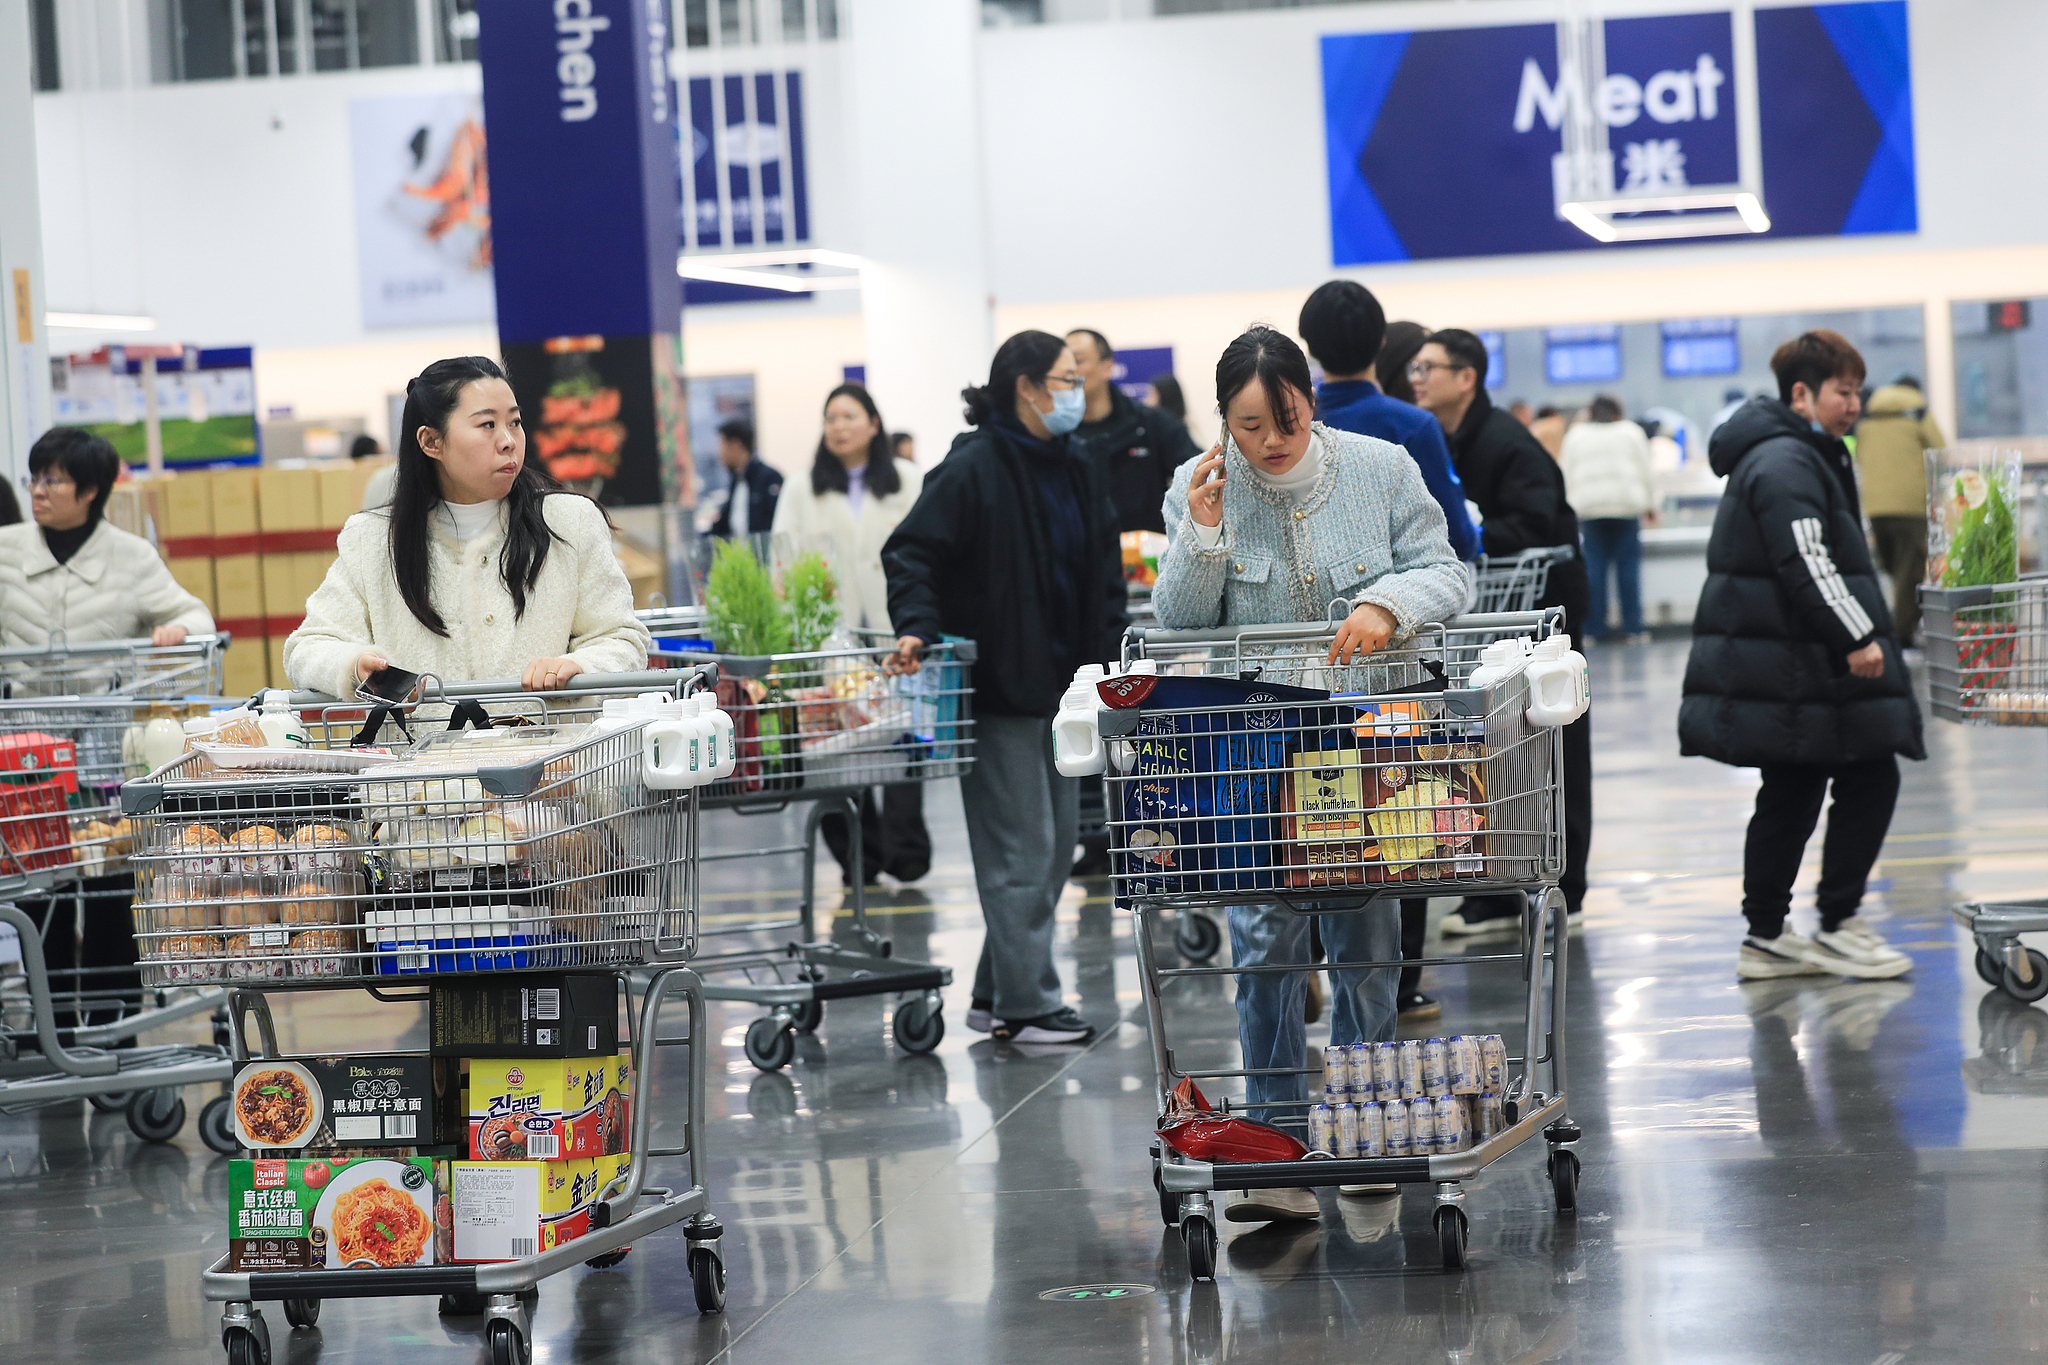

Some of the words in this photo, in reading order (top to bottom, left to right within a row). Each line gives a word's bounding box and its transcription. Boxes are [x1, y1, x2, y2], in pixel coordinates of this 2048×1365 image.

[1513, 53, 1725, 133] Meat
[1342, 797, 1356, 809] Ham
[354, 1080, 399, 1097] 黑松露
[332, 1097, 422, 1114] 黑椒厚牛意面
[487, 1092, 542, 1119] 진라면
[256, 1169, 284, 1179] Italian
[256, 1177, 285, 1187] Classic
[570, 1167, 599, 1211] 金拉面
[243, 1189, 297, 1209] 意式经典
[238, 1208, 303, 1228] 番茄肉酱面
